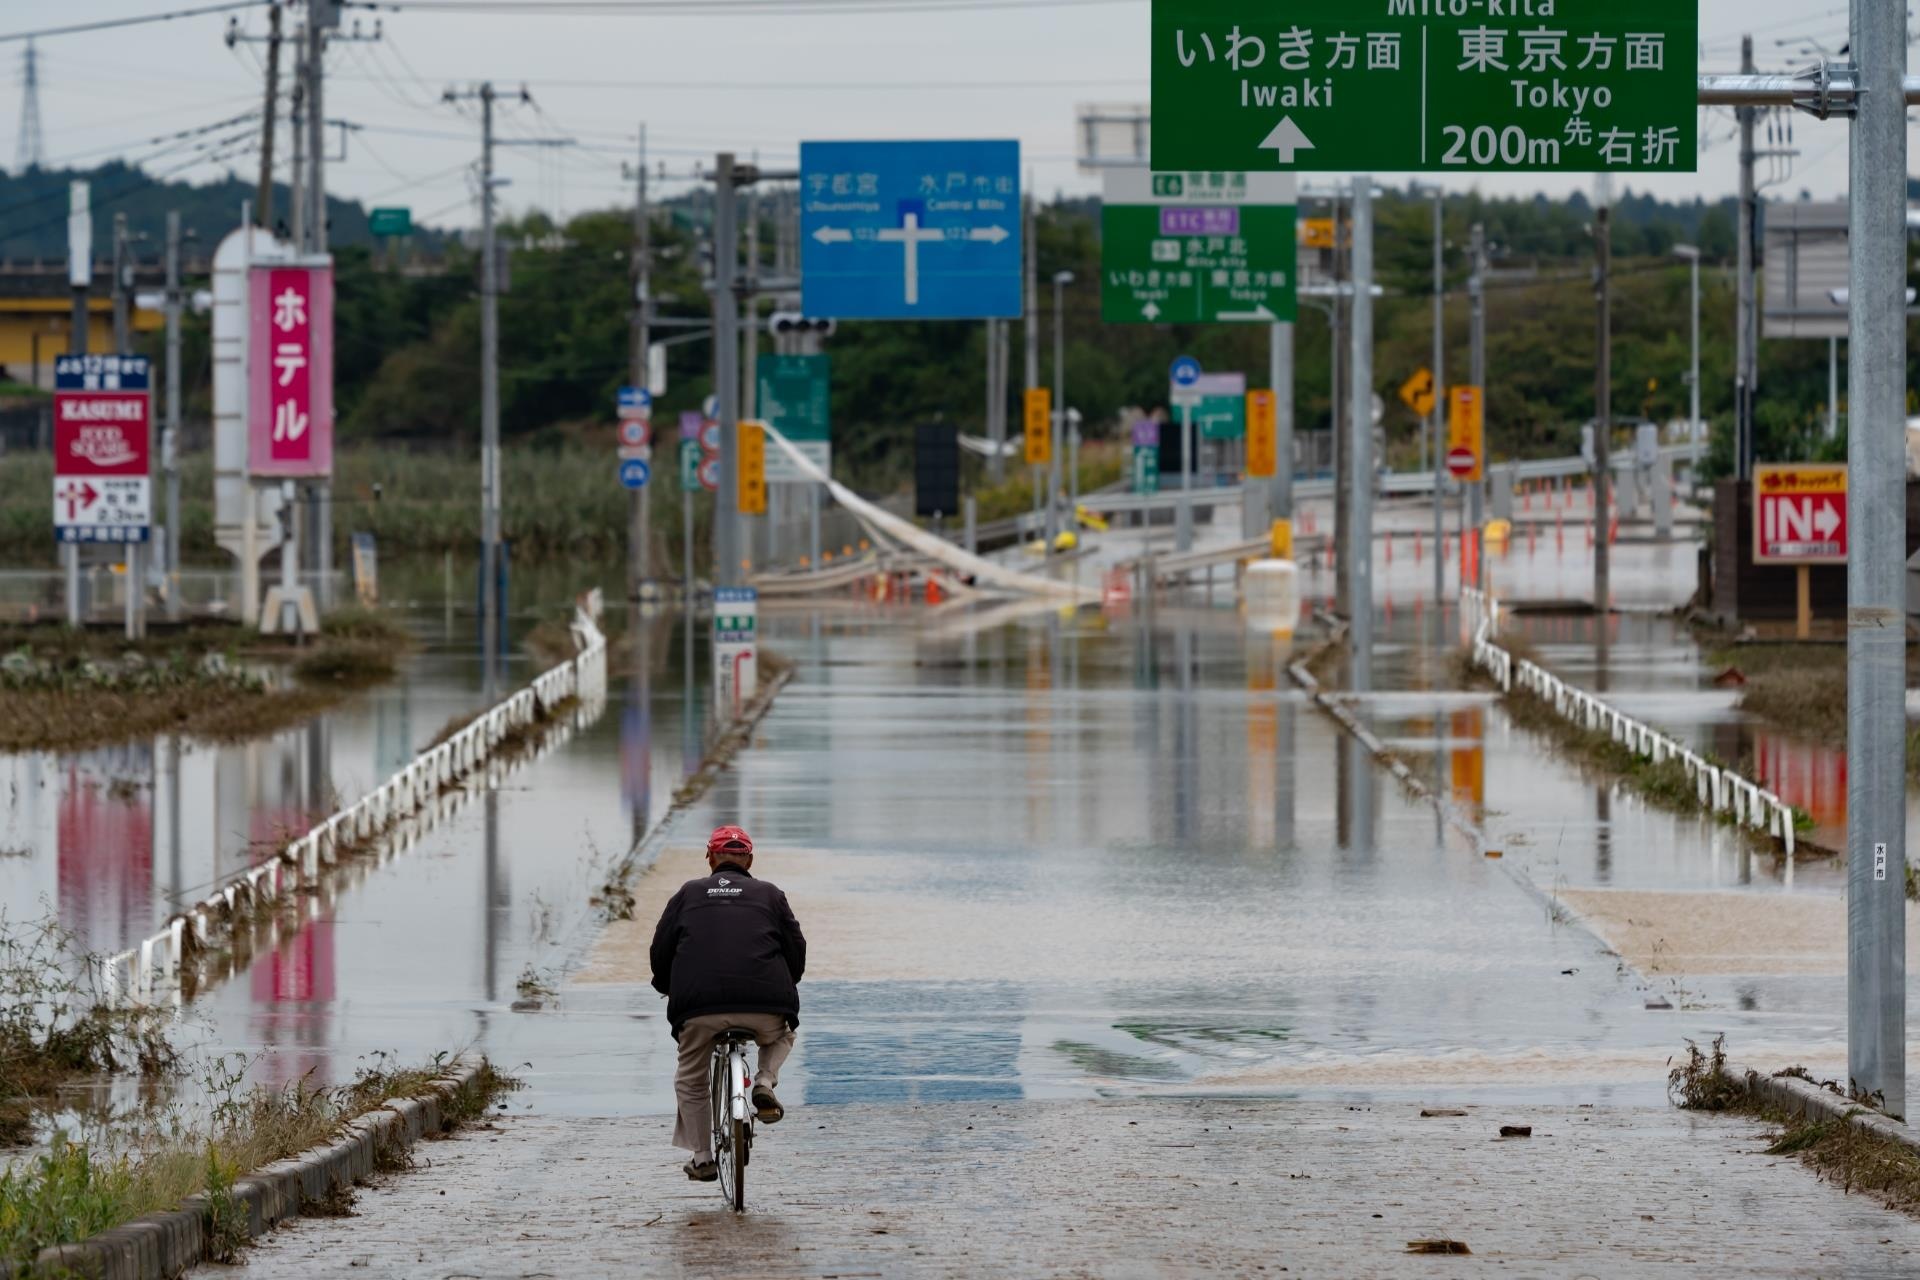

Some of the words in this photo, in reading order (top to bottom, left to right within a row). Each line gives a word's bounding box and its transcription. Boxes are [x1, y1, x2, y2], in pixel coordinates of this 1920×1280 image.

[1176, 25, 1402, 71] いわき方面
[1456, 24, 1666, 73] 東京方面
[1241, 77, 1333, 107] Iwaki
[1510, 78, 1612, 115] Tokyo
[807, 171, 879, 196] 宇都宮
[917, 171, 1014, 195] 水戸市街
[1186, 237, 1247, 256] 水戸北
[1109, 270, 1193, 287] いわき方面
[1211, 270, 1286, 288] 東京方面
[273, 286, 309, 442] ホテル
[61, 400, 143, 421] KASUMI
[1763, 497, 1813, 541] IN
[1876, 845, 1885, 879] 水戸市
